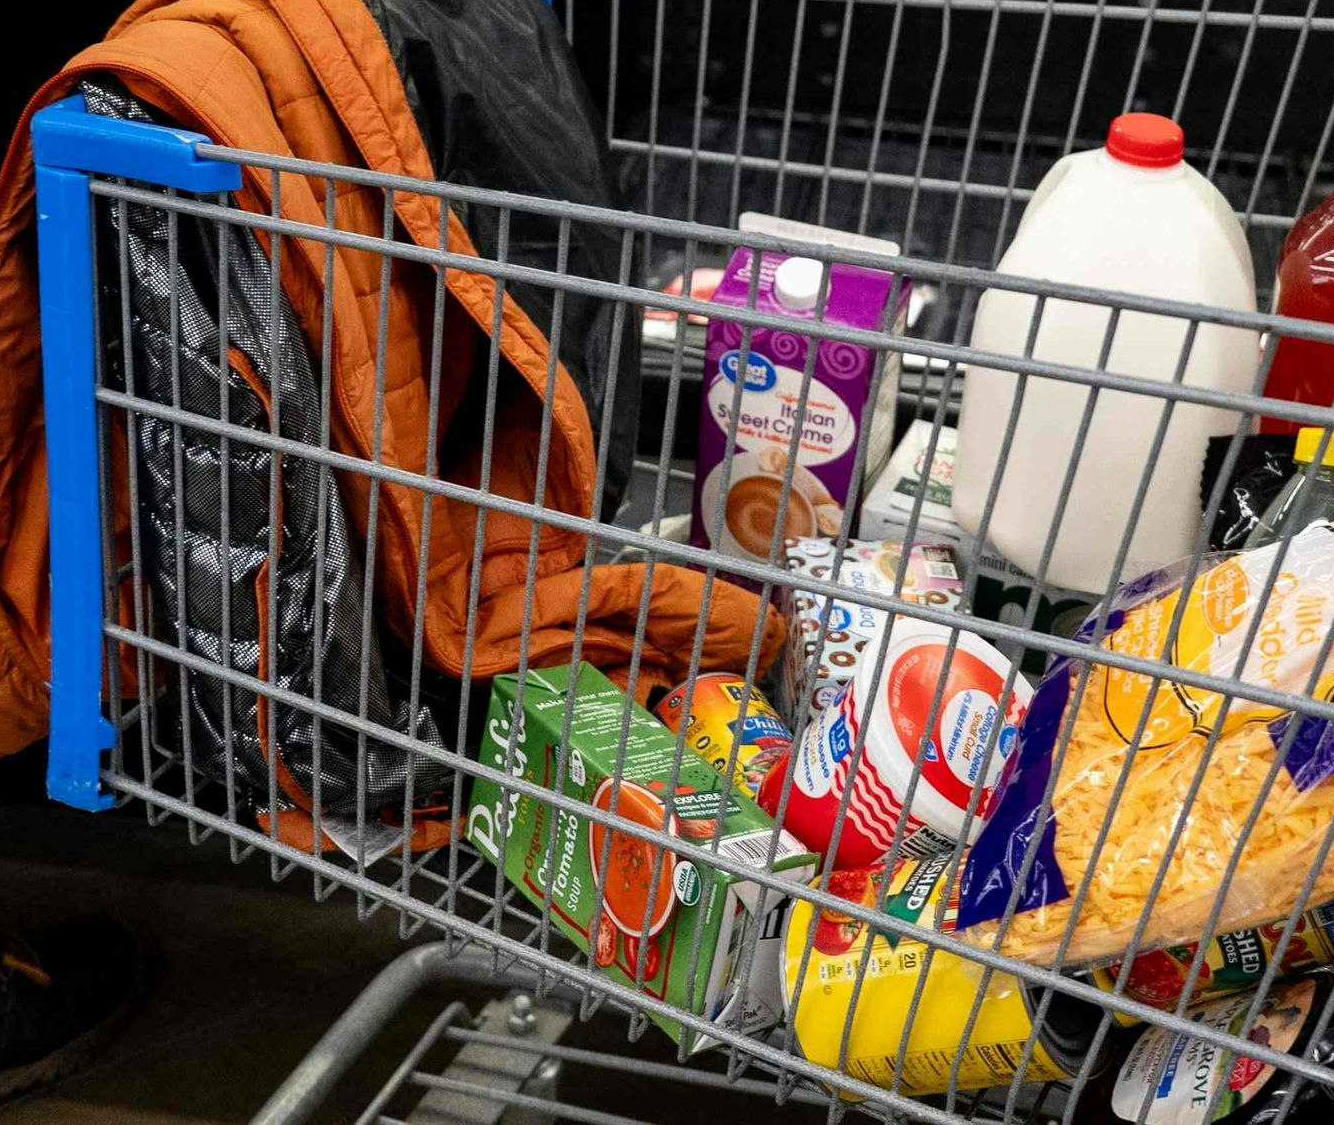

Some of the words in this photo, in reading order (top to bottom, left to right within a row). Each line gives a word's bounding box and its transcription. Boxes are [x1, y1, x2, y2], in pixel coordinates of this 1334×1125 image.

[728, 357, 768, 378] Geat
[718, 403, 769, 429] Seet
[772, 419, 833, 444] Crme
[979, 555, 1007, 572] mini
[673, 792, 723, 806] EXPLORE
[552, 814, 579, 899] Tomato
[568, 875, 583, 912] SOUP
[677, 866, 690, 893] USDA
[907, 853, 950, 910] USHED
[903, 952, 917, 969] 20
[1222, 933, 1238, 964] ATOES
[1234, 929, 1260, 974] SHED
